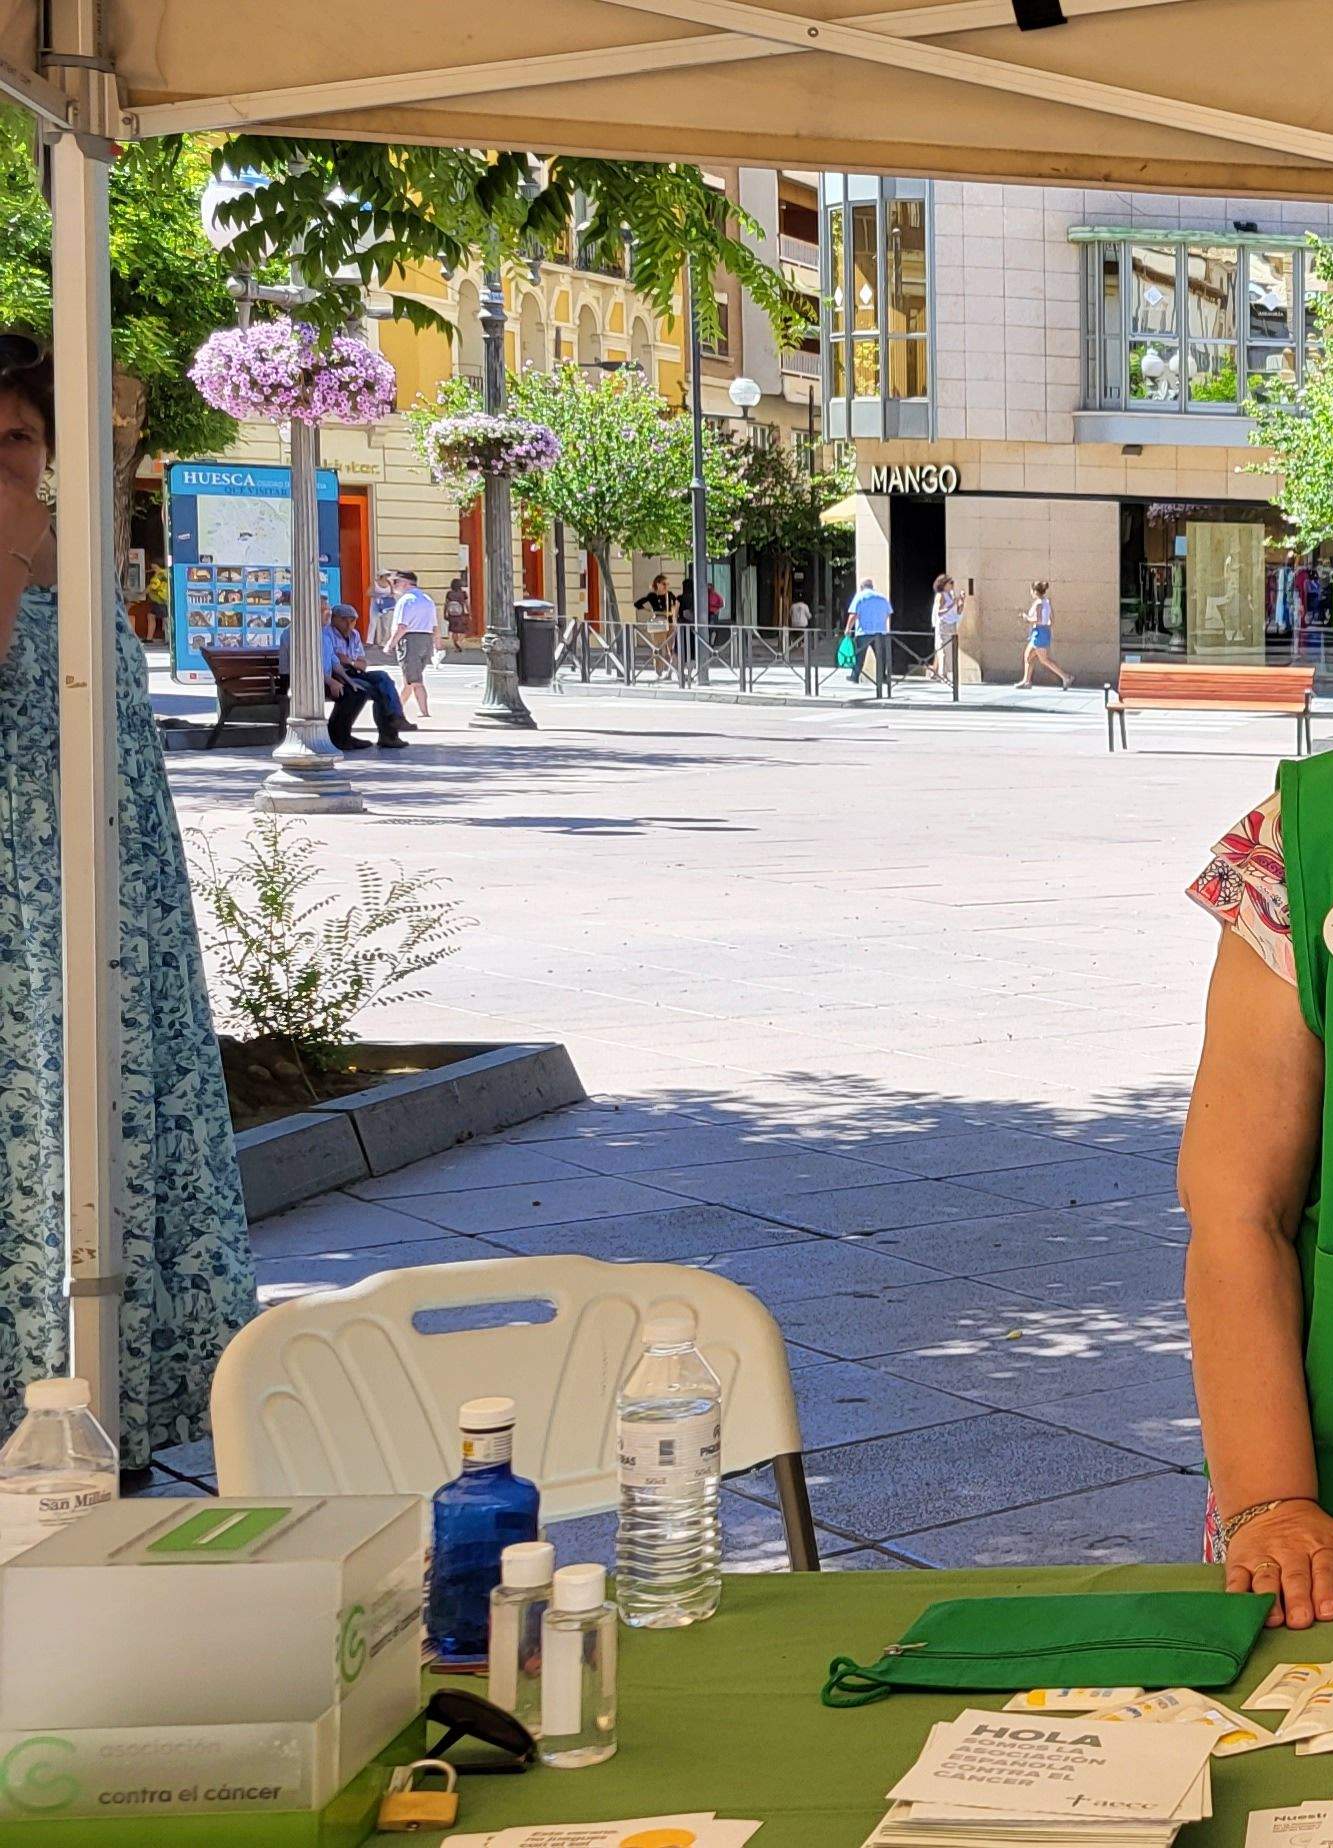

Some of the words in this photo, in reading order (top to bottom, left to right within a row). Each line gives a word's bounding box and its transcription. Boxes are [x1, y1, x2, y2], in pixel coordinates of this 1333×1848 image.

[183, 470, 255, 487] HUESCA
[871, 463, 958, 493] MANGO
[39, 1497, 70, 1512] San
[970, 1723, 1103, 1748] HOLA
[953, 1744, 1107, 1766] ASOCIACIÓN
[963, 1737, 1050, 1752] SOMOS
[1055, 1745, 1085, 1756] LA
[940, 1761, 1041, 1779] CONTRA
[1047, 1772, 1075, 1782] EL
[99, 1787, 172, 1806] contra
[178, 1785, 199, 1802] el
[203, 1782, 283, 1802] cáncer
